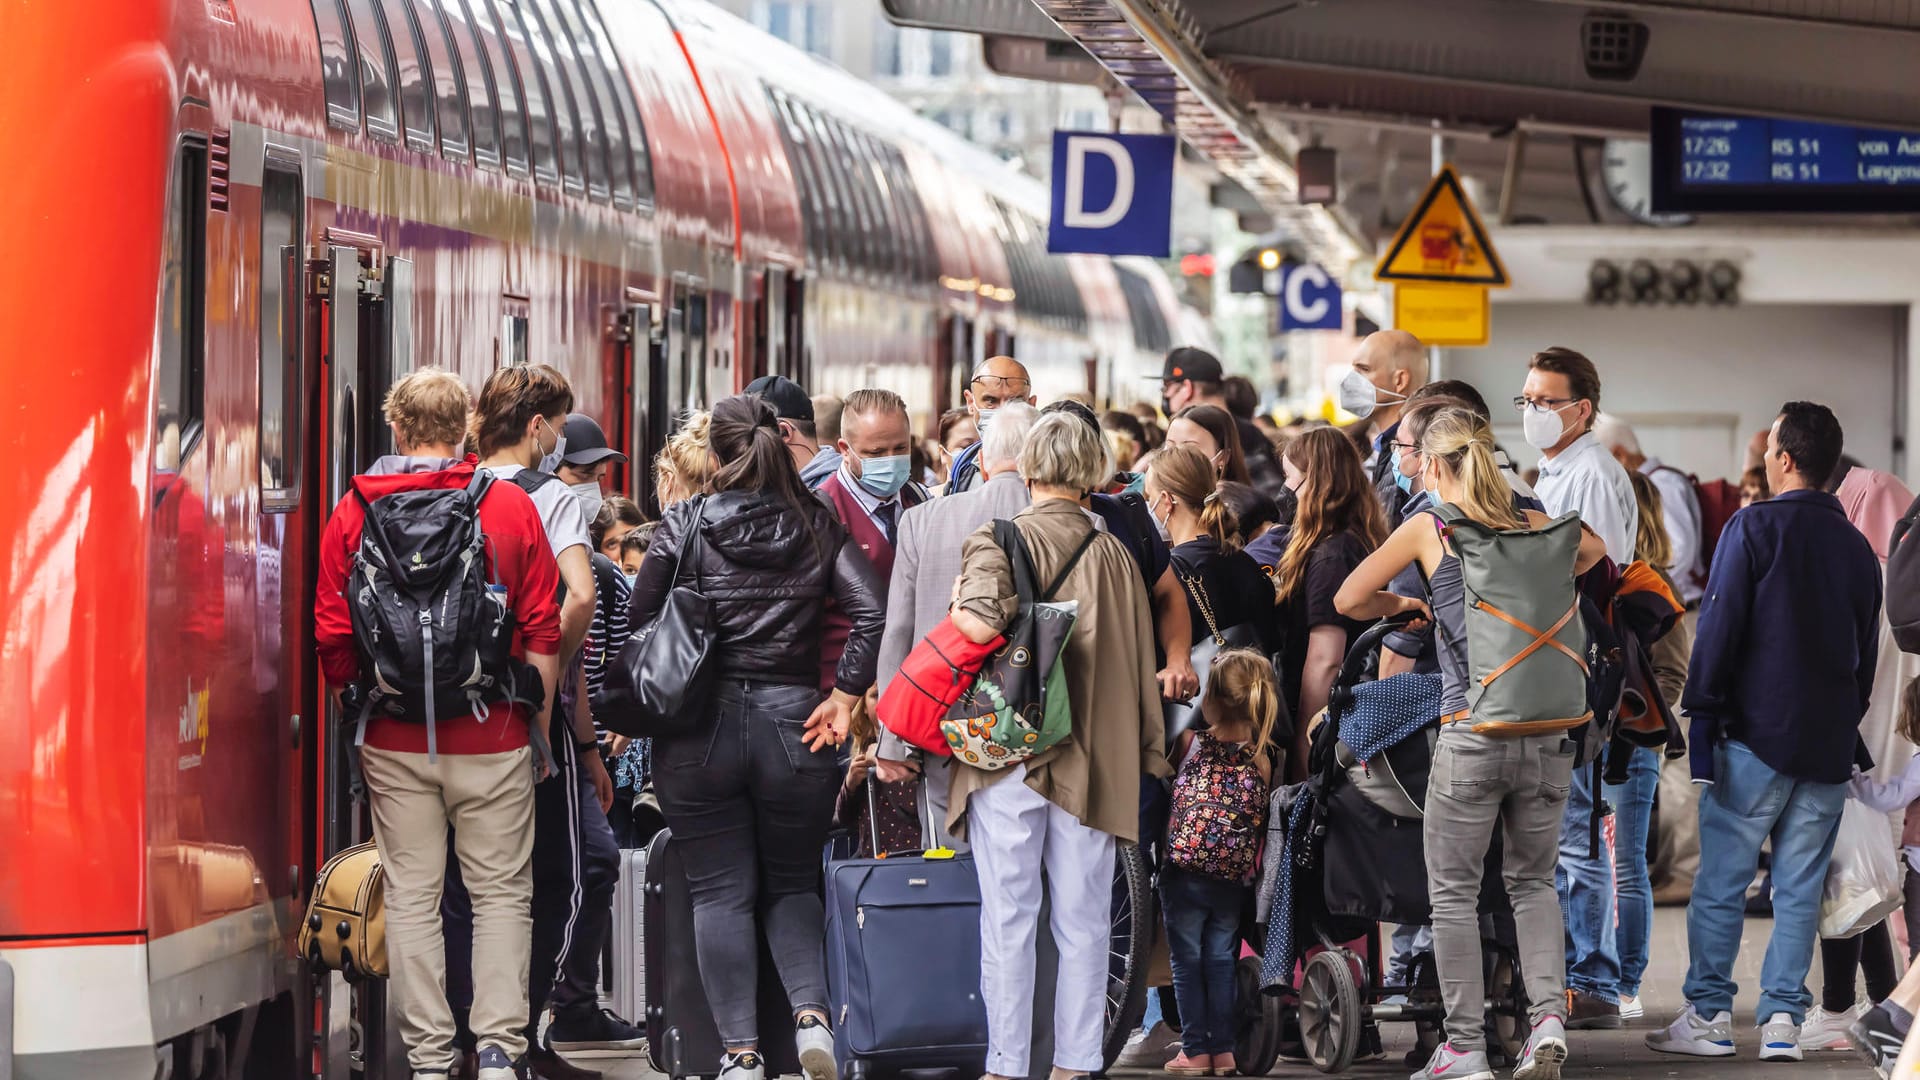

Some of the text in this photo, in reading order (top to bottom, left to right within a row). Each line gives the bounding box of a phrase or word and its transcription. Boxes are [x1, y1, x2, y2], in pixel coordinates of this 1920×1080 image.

[1684, 137, 1730, 155] 17:26
[1772, 139, 1794, 156] RS
[1800, 139, 1819, 156] 51
[1858, 141, 1889, 156] von
[1063, 135, 1135, 229] D
[1684, 161, 1730, 180] 17:32
[1772, 162, 1794, 180] RS
[1800, 162, 1819, 180] 51
[1285, 264, 1330, 323] C
